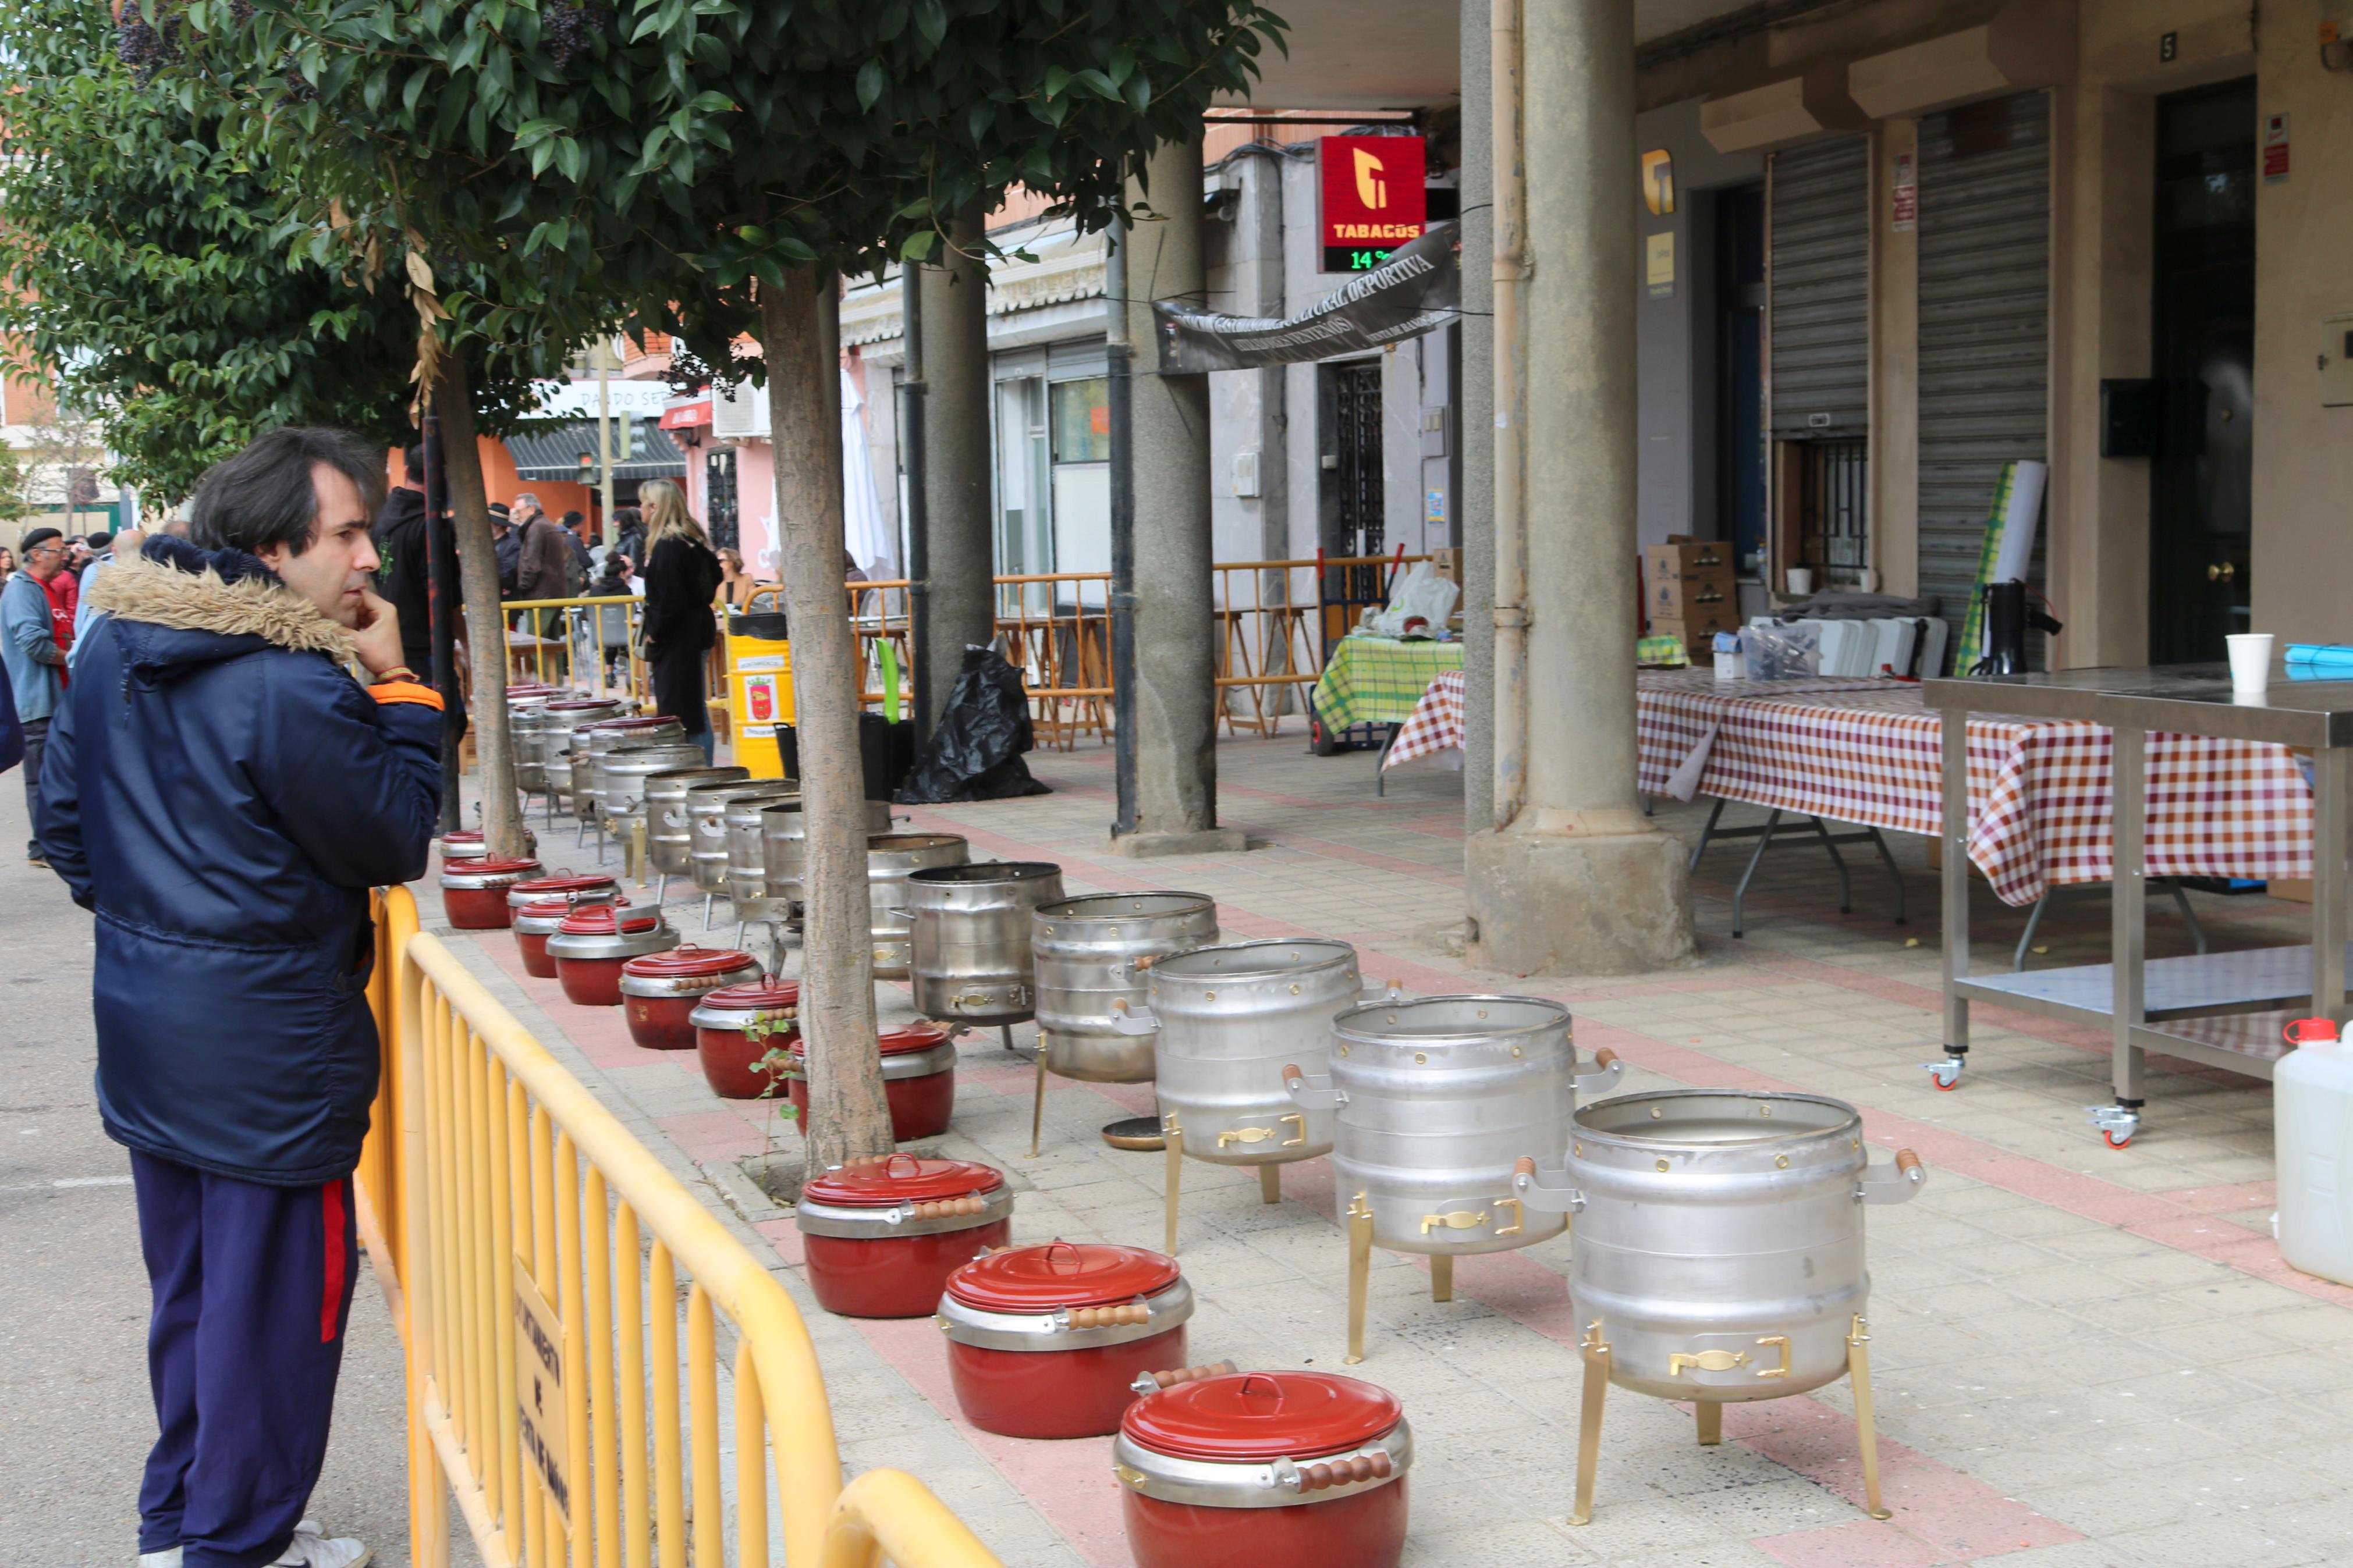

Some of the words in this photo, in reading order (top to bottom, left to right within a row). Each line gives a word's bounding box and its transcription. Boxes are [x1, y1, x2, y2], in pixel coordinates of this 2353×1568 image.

[2164, 37, 2173, 58] 5
[1333, 223, 1420, 239] TABACOS
[1351, 251, 1372, 269] 14
[1347, 254, 1435, 302] DEPORTIVA
